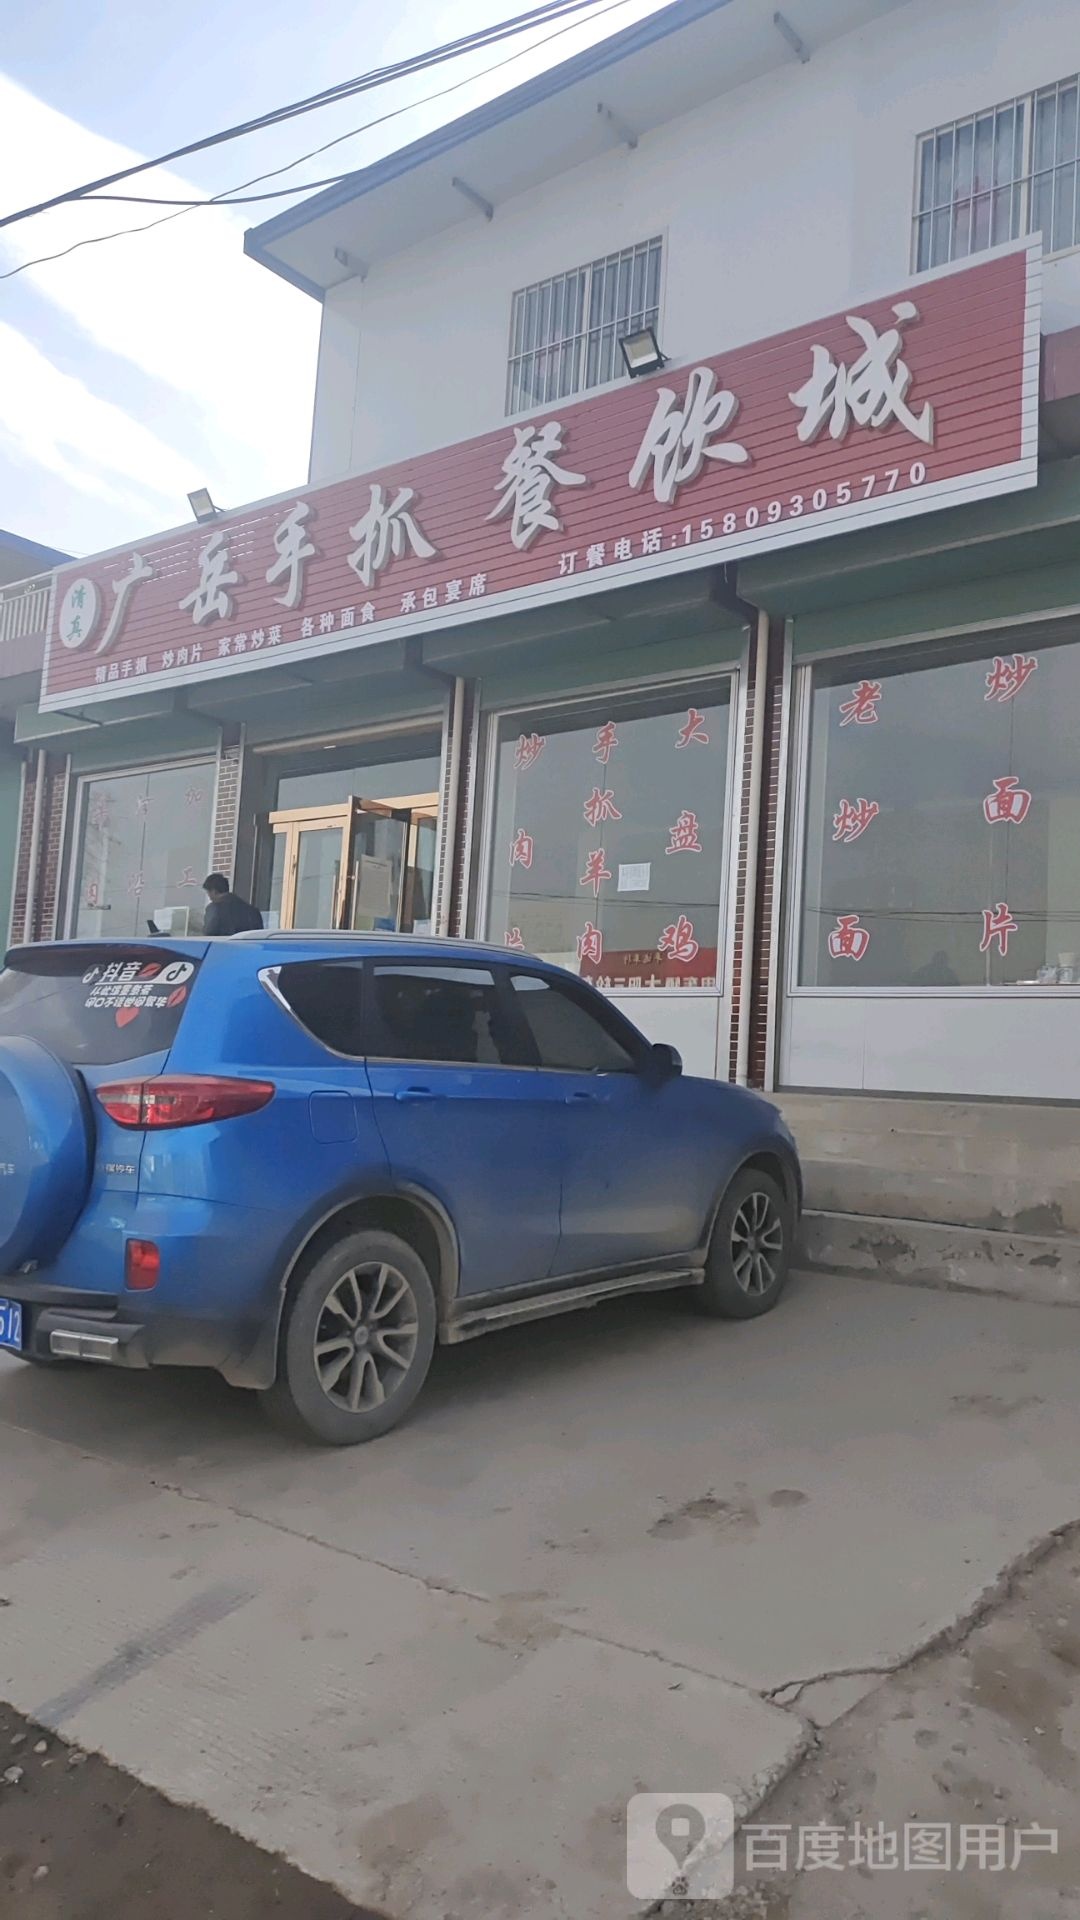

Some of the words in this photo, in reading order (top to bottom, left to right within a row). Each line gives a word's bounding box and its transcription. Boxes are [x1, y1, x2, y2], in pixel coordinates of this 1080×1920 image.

[96, 301, 935, 655] 广岳手抓餐饮城
[66, 585, 87, 641] 清真
[161, 643, 203, 668] 炒肉片
[218, 625, 282, 656] 家常炒菜
[301, 600, 376, 639] 各种面食
[400, 573, 489, 613] 承包宴席
[576, 721, 622, 964] 手抓羊肉
[657, 708, 710, 963] 大盘鸡
[828, 680, 882, 960] 老炒面
[979, 654, 1038, 956] 炒面片
[99, 961, 143, 982] 抖音
